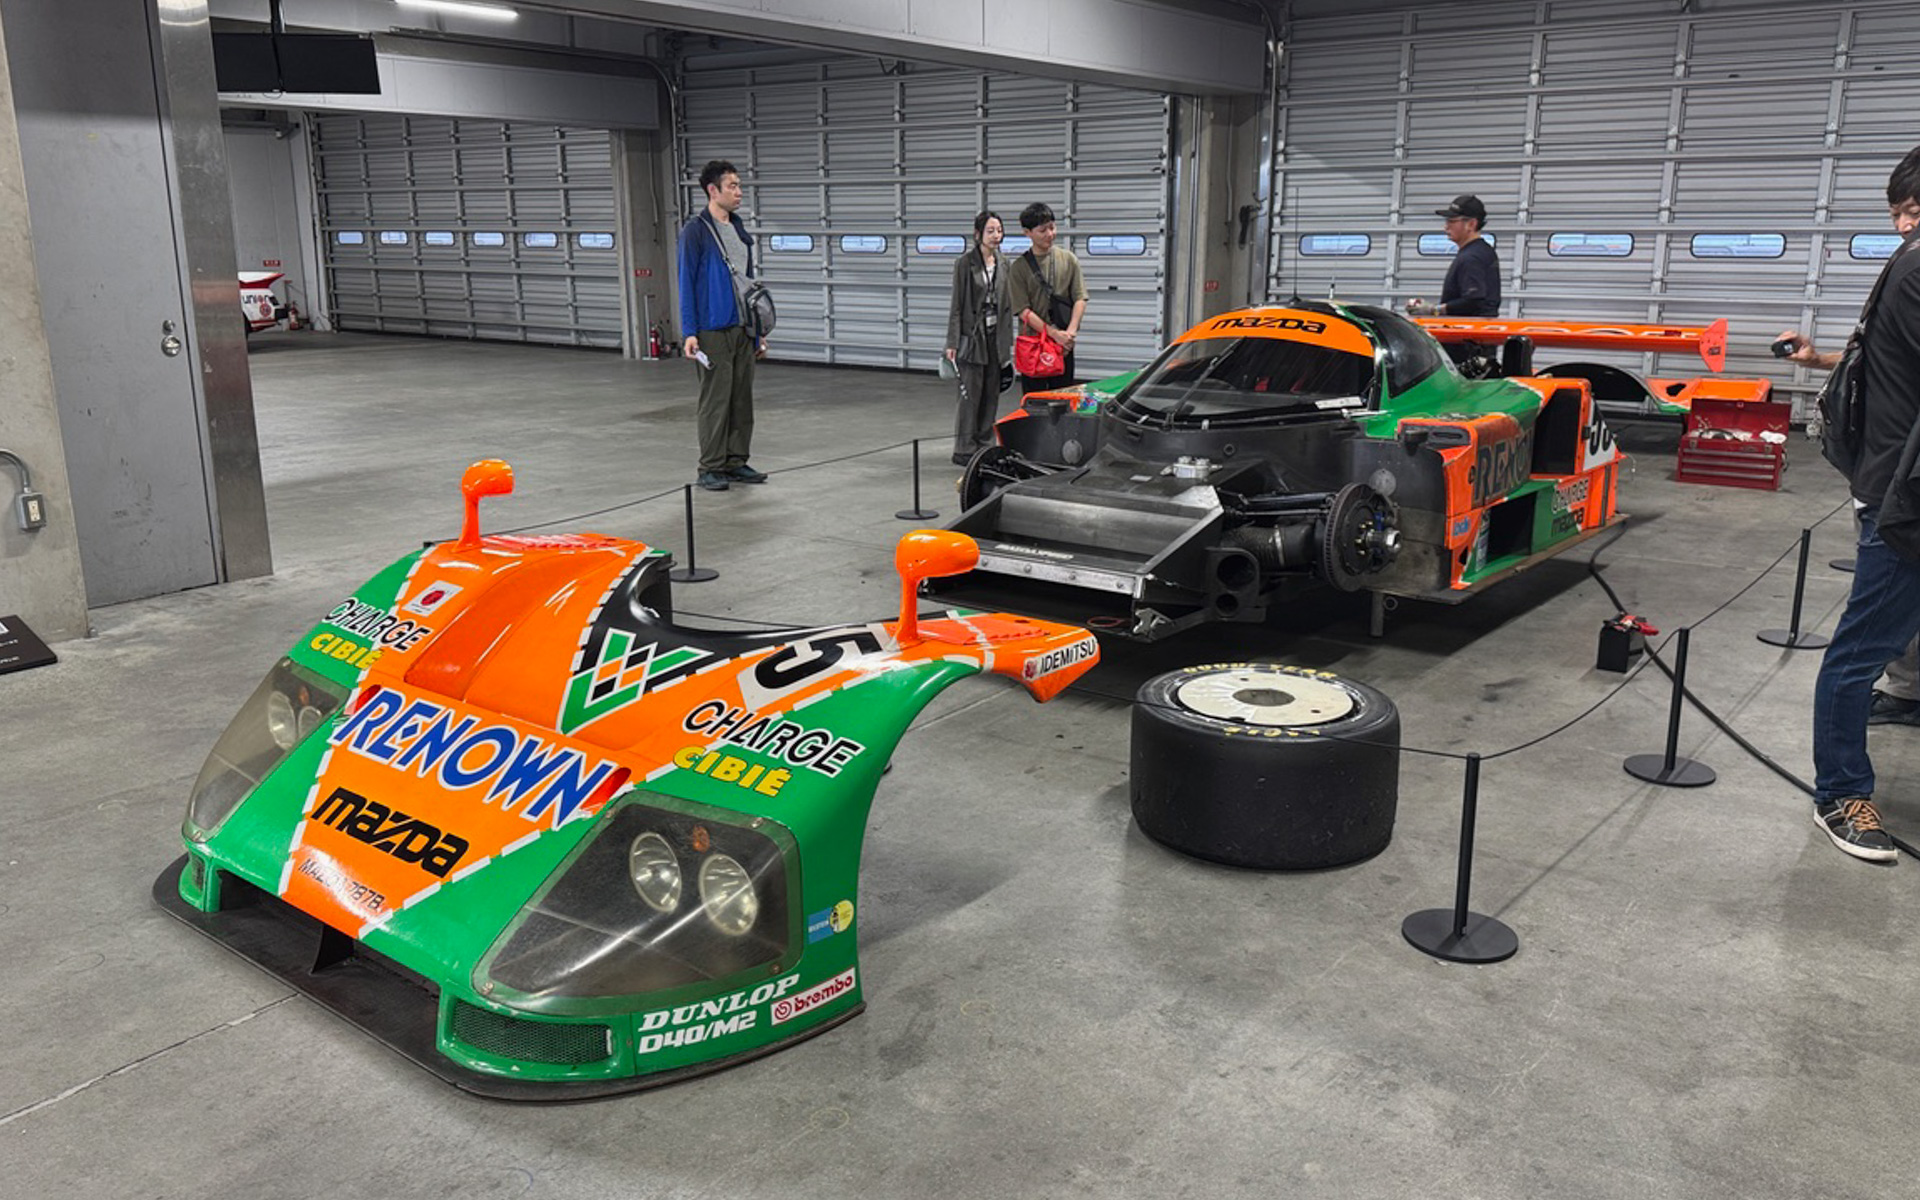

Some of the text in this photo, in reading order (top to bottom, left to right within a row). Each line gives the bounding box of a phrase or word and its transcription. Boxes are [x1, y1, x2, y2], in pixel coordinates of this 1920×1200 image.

[324, 598, 433, 652] CHARGE
[1040, 639, 1096, 675] IDEMITSU
[329, 688, 616, 830] RENOWN
[684, 700, 864, 777] CHARGE
[311, 786, 470, 879] mazda
[348, 881, 385, 909] 787B
[638, 973, 800, 1032] DUNLOP
[794, 975, 854, 1012] brembo
[638, 1010, 757, 1054] D40/M2
